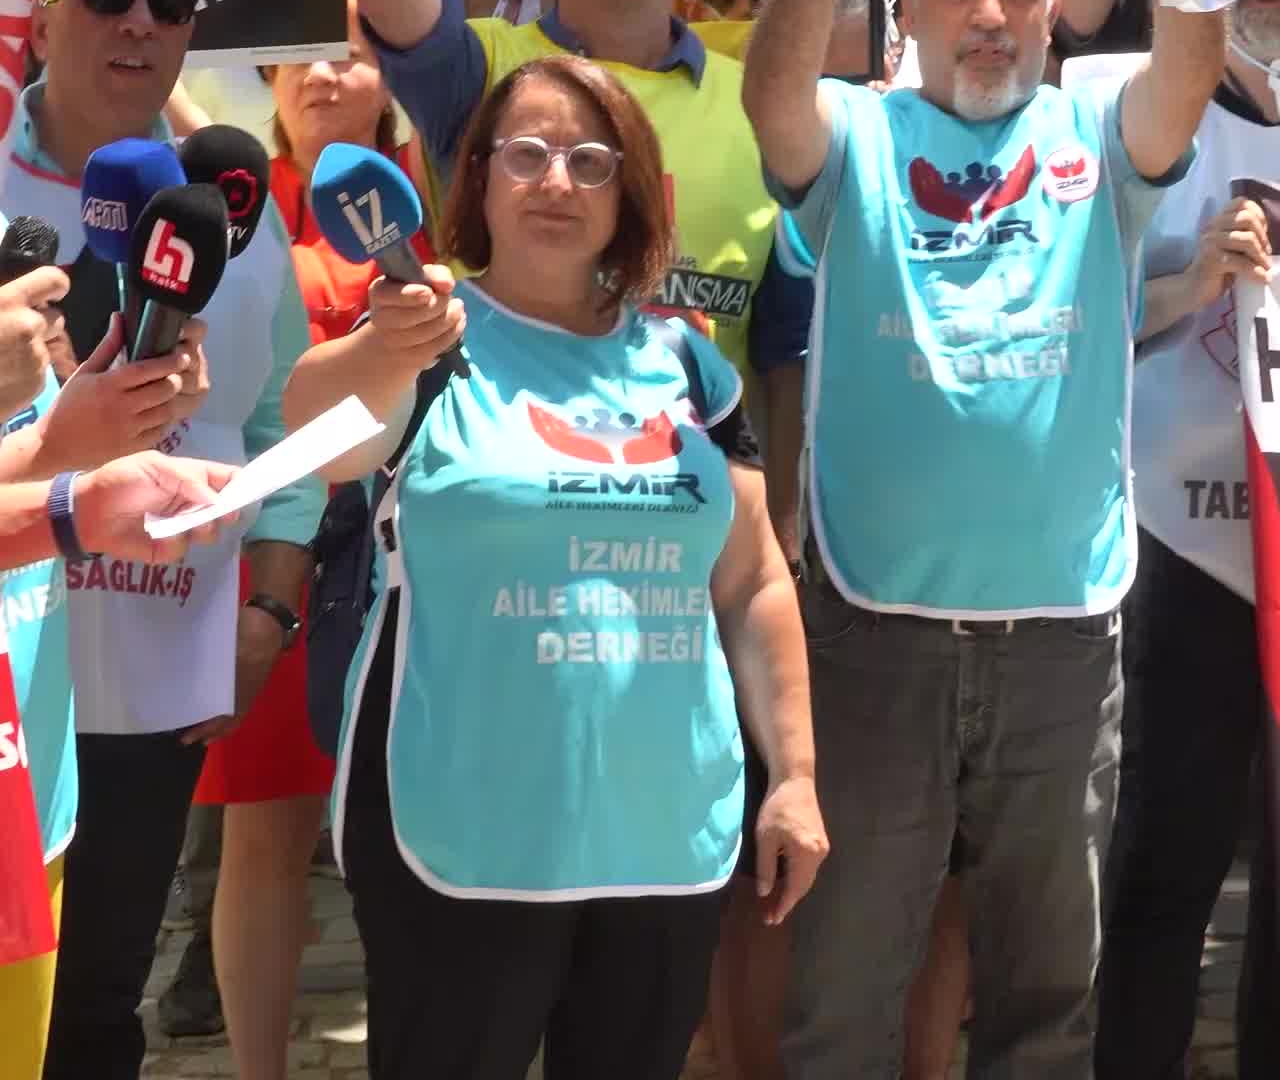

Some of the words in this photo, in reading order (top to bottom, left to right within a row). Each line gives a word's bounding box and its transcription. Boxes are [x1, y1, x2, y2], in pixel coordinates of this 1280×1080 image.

[569, 535, 683, 573] İZMİR
[493, 579, 569, 617] AİLE
[577, 579, 711, 617] HEKİMLE
[537, 623, 703, 664] DERNEĞİ
